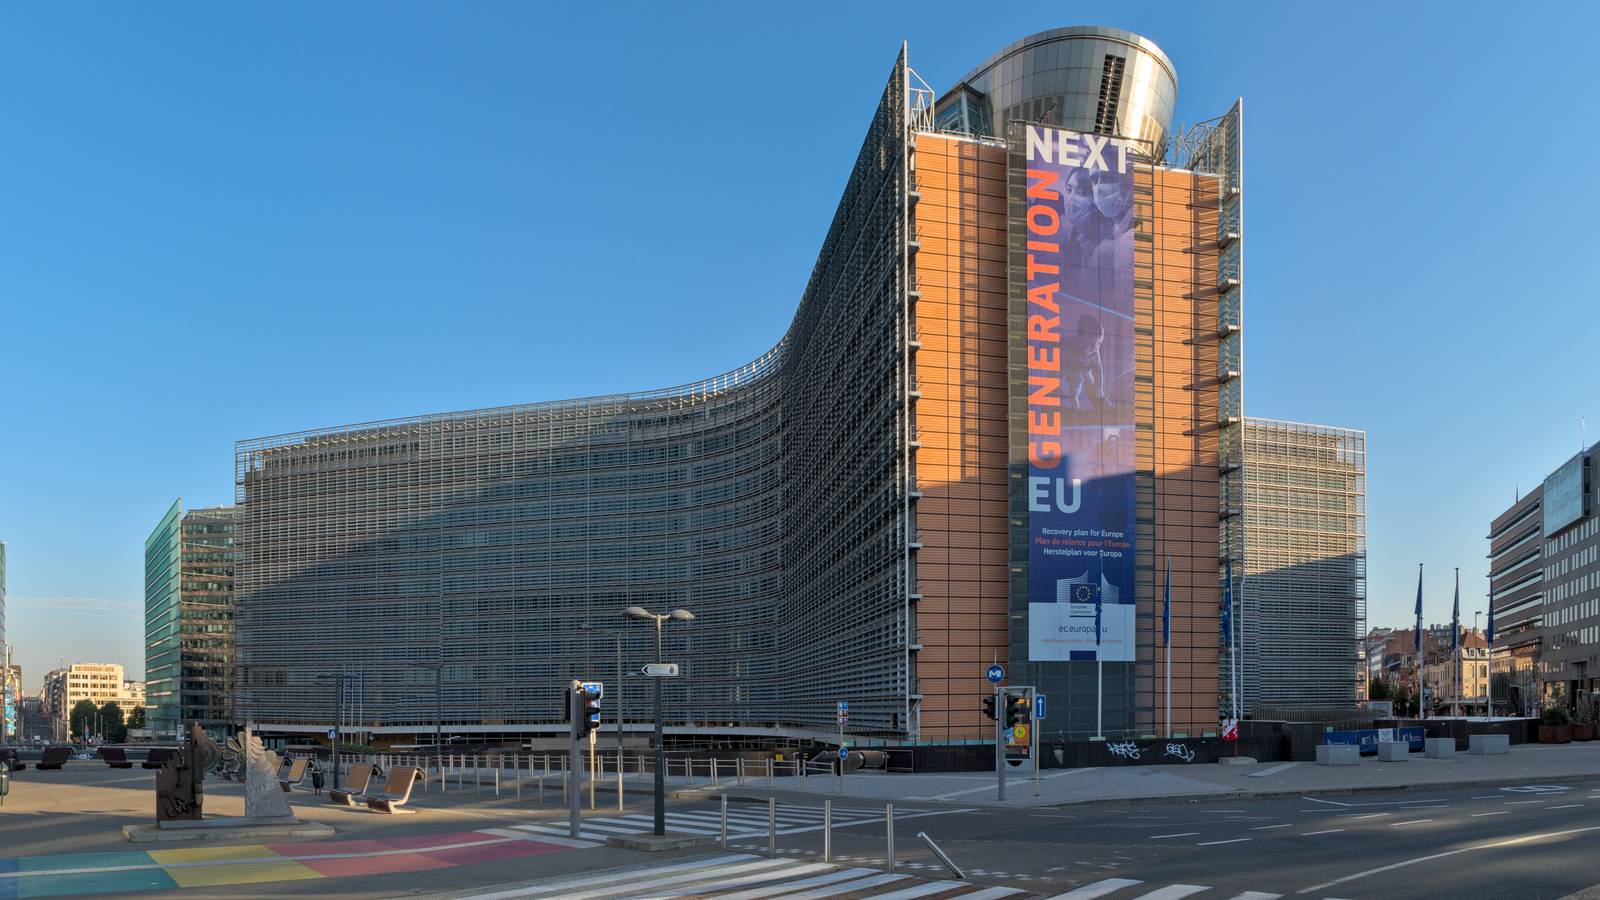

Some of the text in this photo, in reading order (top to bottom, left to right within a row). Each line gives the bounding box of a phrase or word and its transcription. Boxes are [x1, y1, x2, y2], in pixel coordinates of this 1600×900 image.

[1026, 125, 1131, 174] NEXT
[1026, 169, 1061, 469] GENERATION
[1028, 476, 1082, 514] EU
[1042, 527, 1072, 536] Recovery
[1073, 529, 1088, 537] plan
[1101, 530, 1124, 538] Europe
[1035, 537, 1050, 545] Plan
[1087, 540, 1103, 548] pour
[1043, 548, 1081, 557] Herstelplan
[1099, 550, 1122, 558] Europa
[1058, 625, 1107, 634] ec.europau
